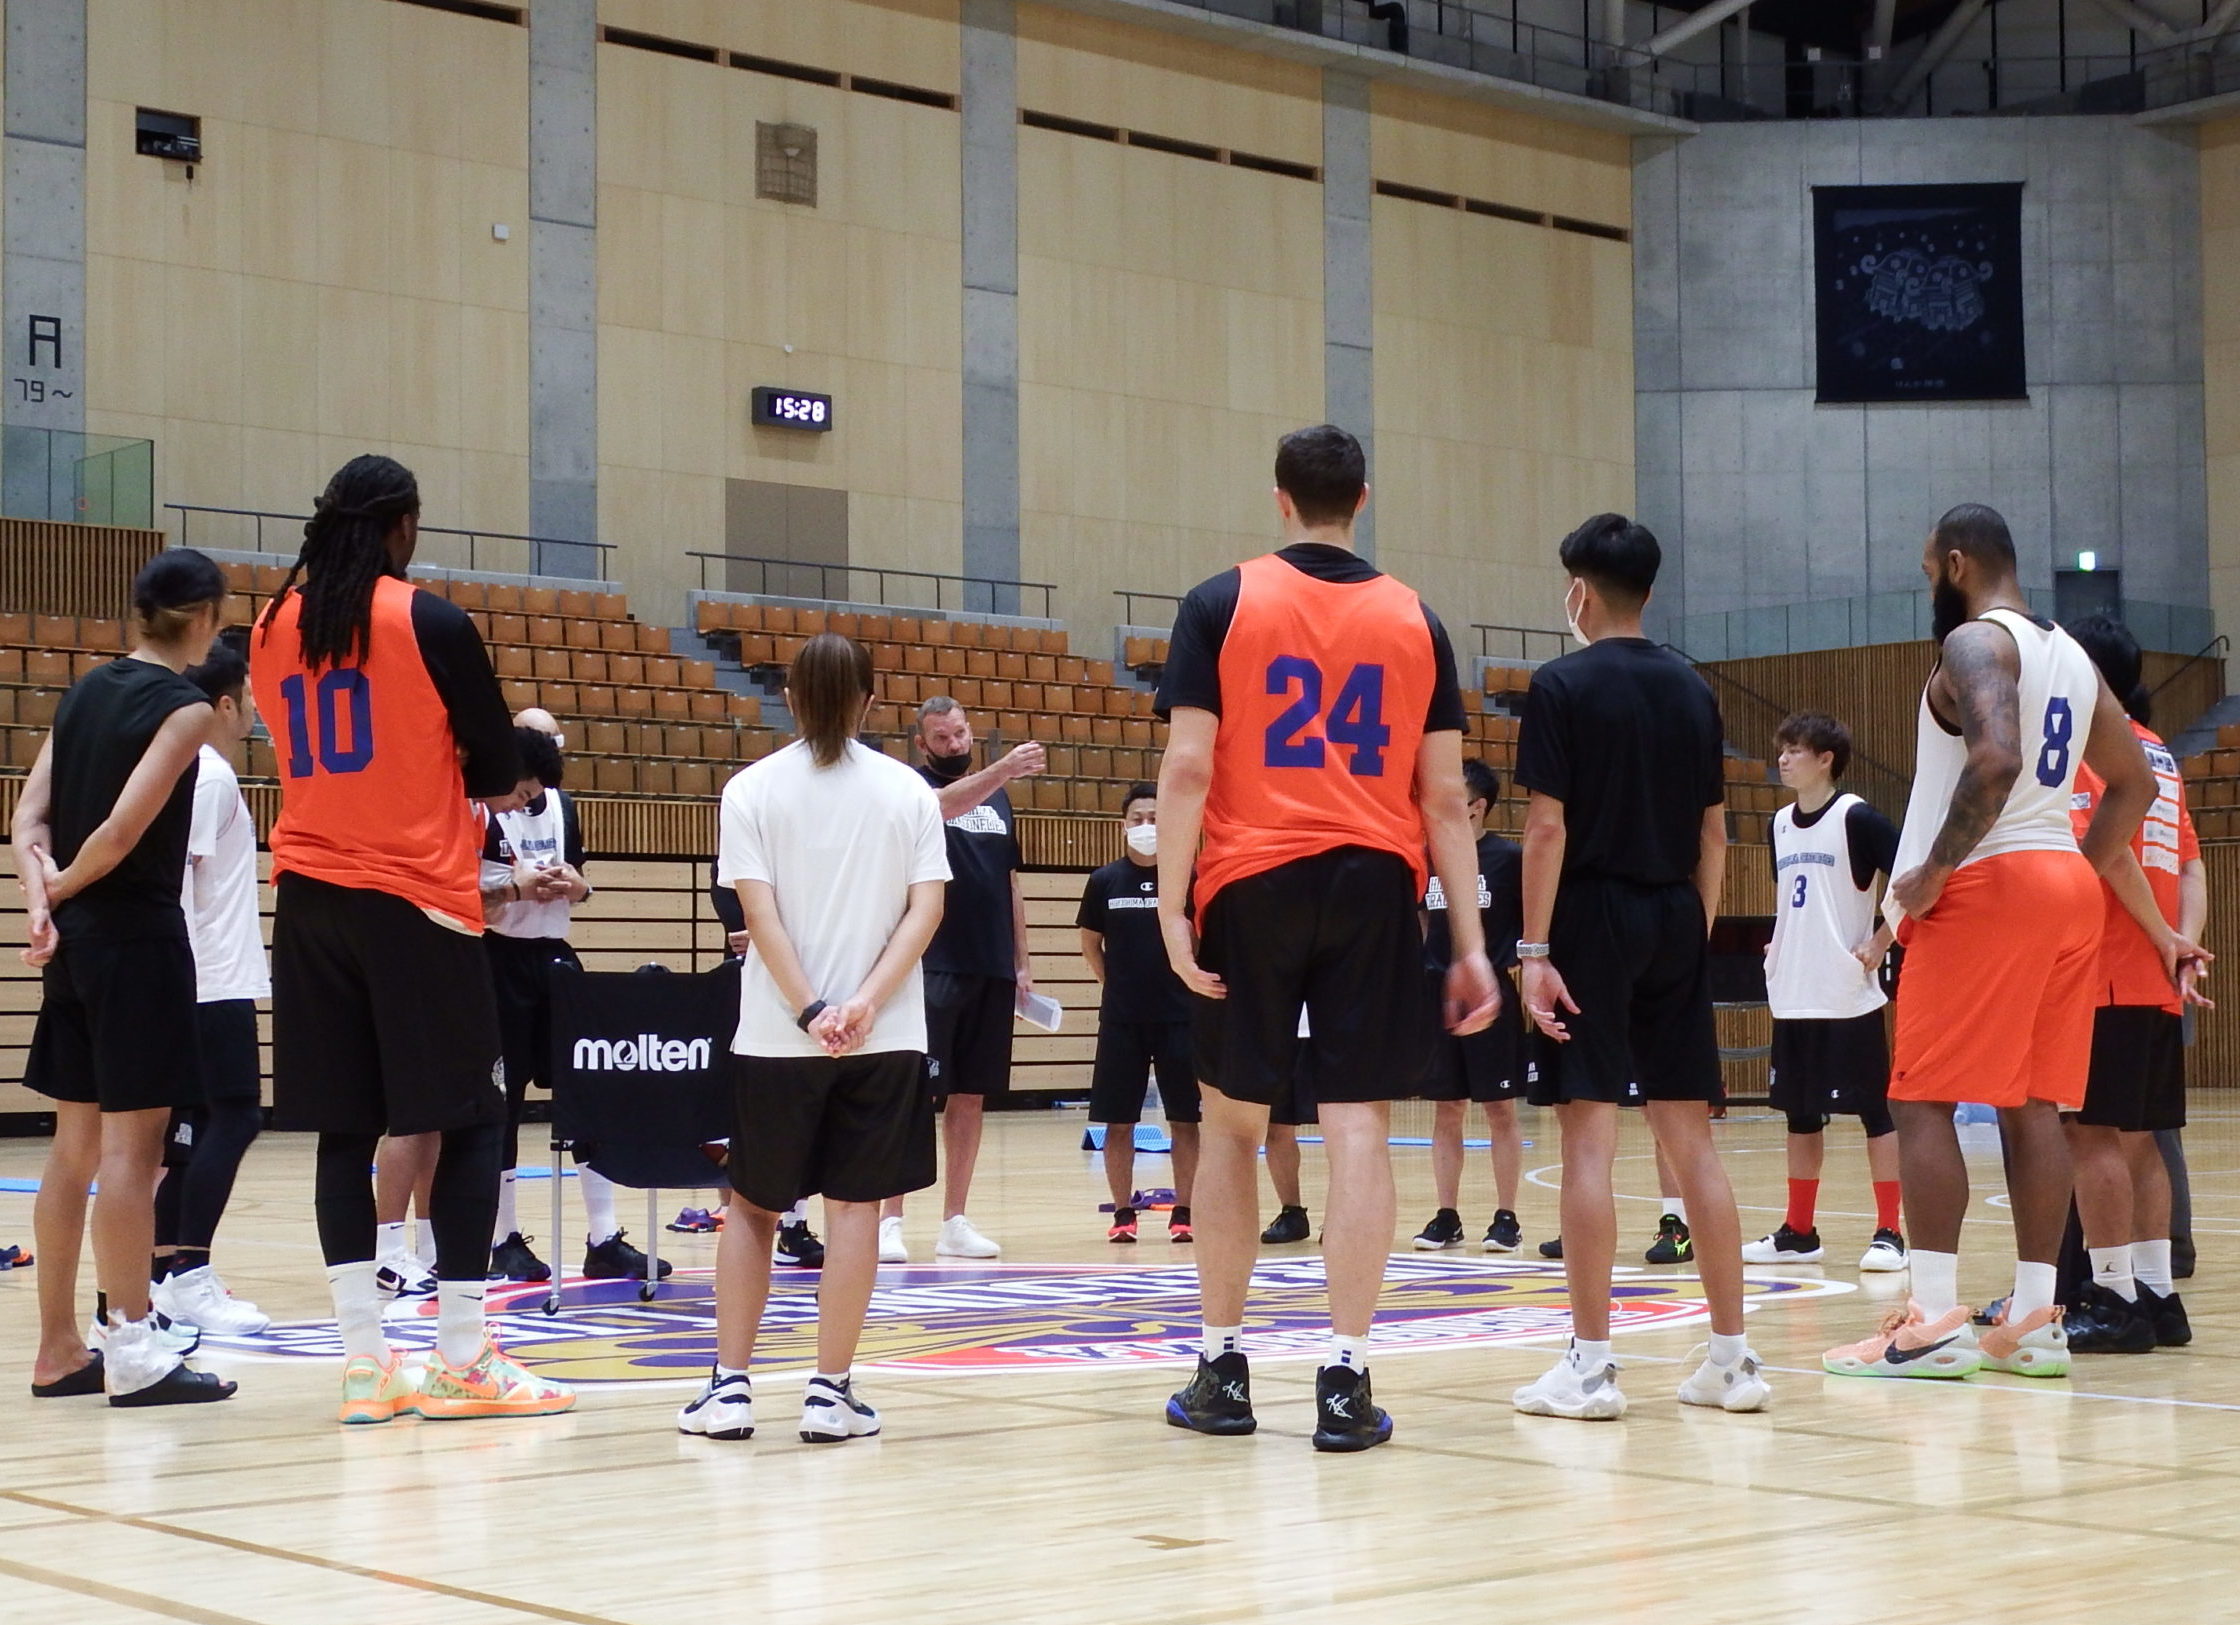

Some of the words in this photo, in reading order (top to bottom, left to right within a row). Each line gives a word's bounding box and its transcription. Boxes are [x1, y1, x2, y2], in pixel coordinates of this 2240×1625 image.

[29, 314, 61, 369] A
[775, 397, 825, 422] 15:28
[280, 668, 373, 778] 10
[1264, 654, 1390, 776] 24
[2036, 696, 2072, 788] 8
[1792, 875, 1807, 908] 3
[573, 1034, 712, 1072] molten
